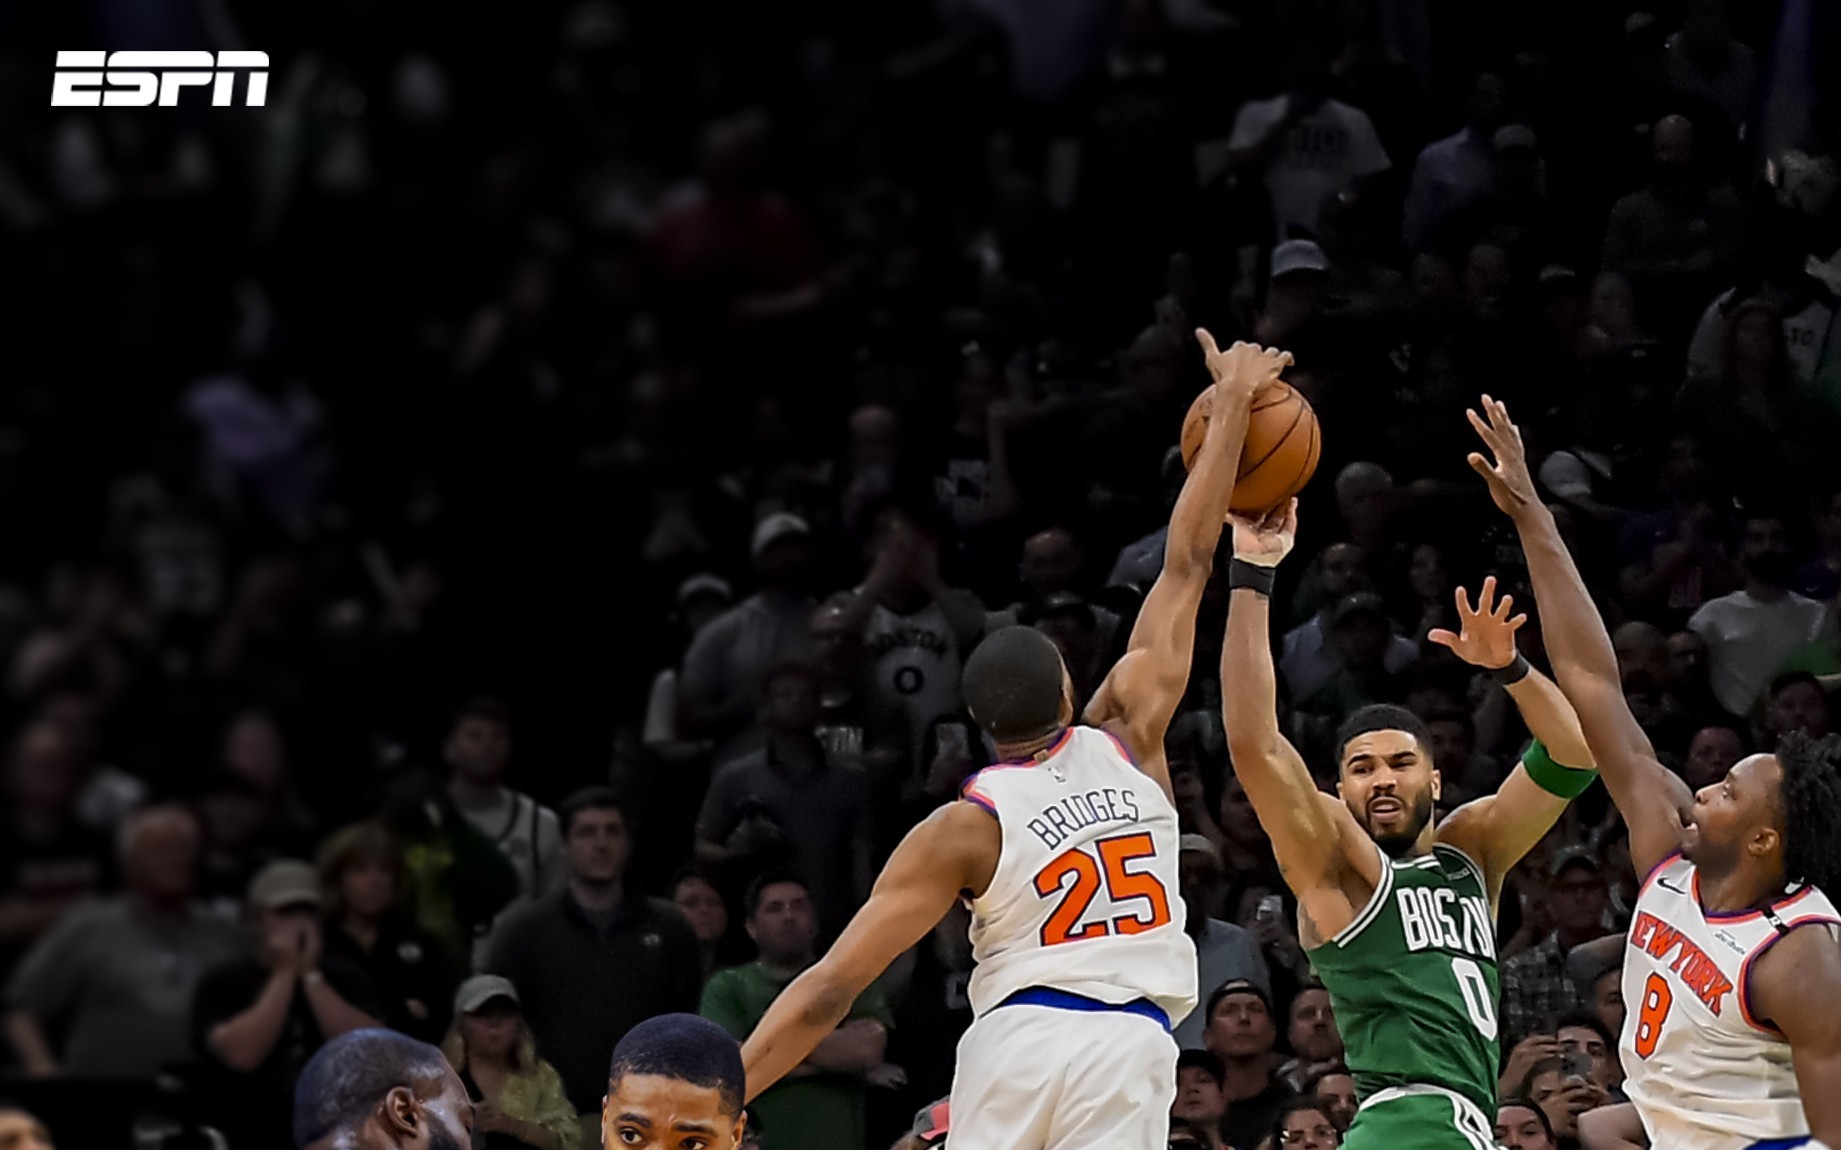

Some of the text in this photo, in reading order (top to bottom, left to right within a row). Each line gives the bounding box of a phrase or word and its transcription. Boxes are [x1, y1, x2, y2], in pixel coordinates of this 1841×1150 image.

[1027, 789, 1139, 850] BRIDGES
[1033, 830, 1171, 947] 25
[1635, 971, 1673, 1060] 8
